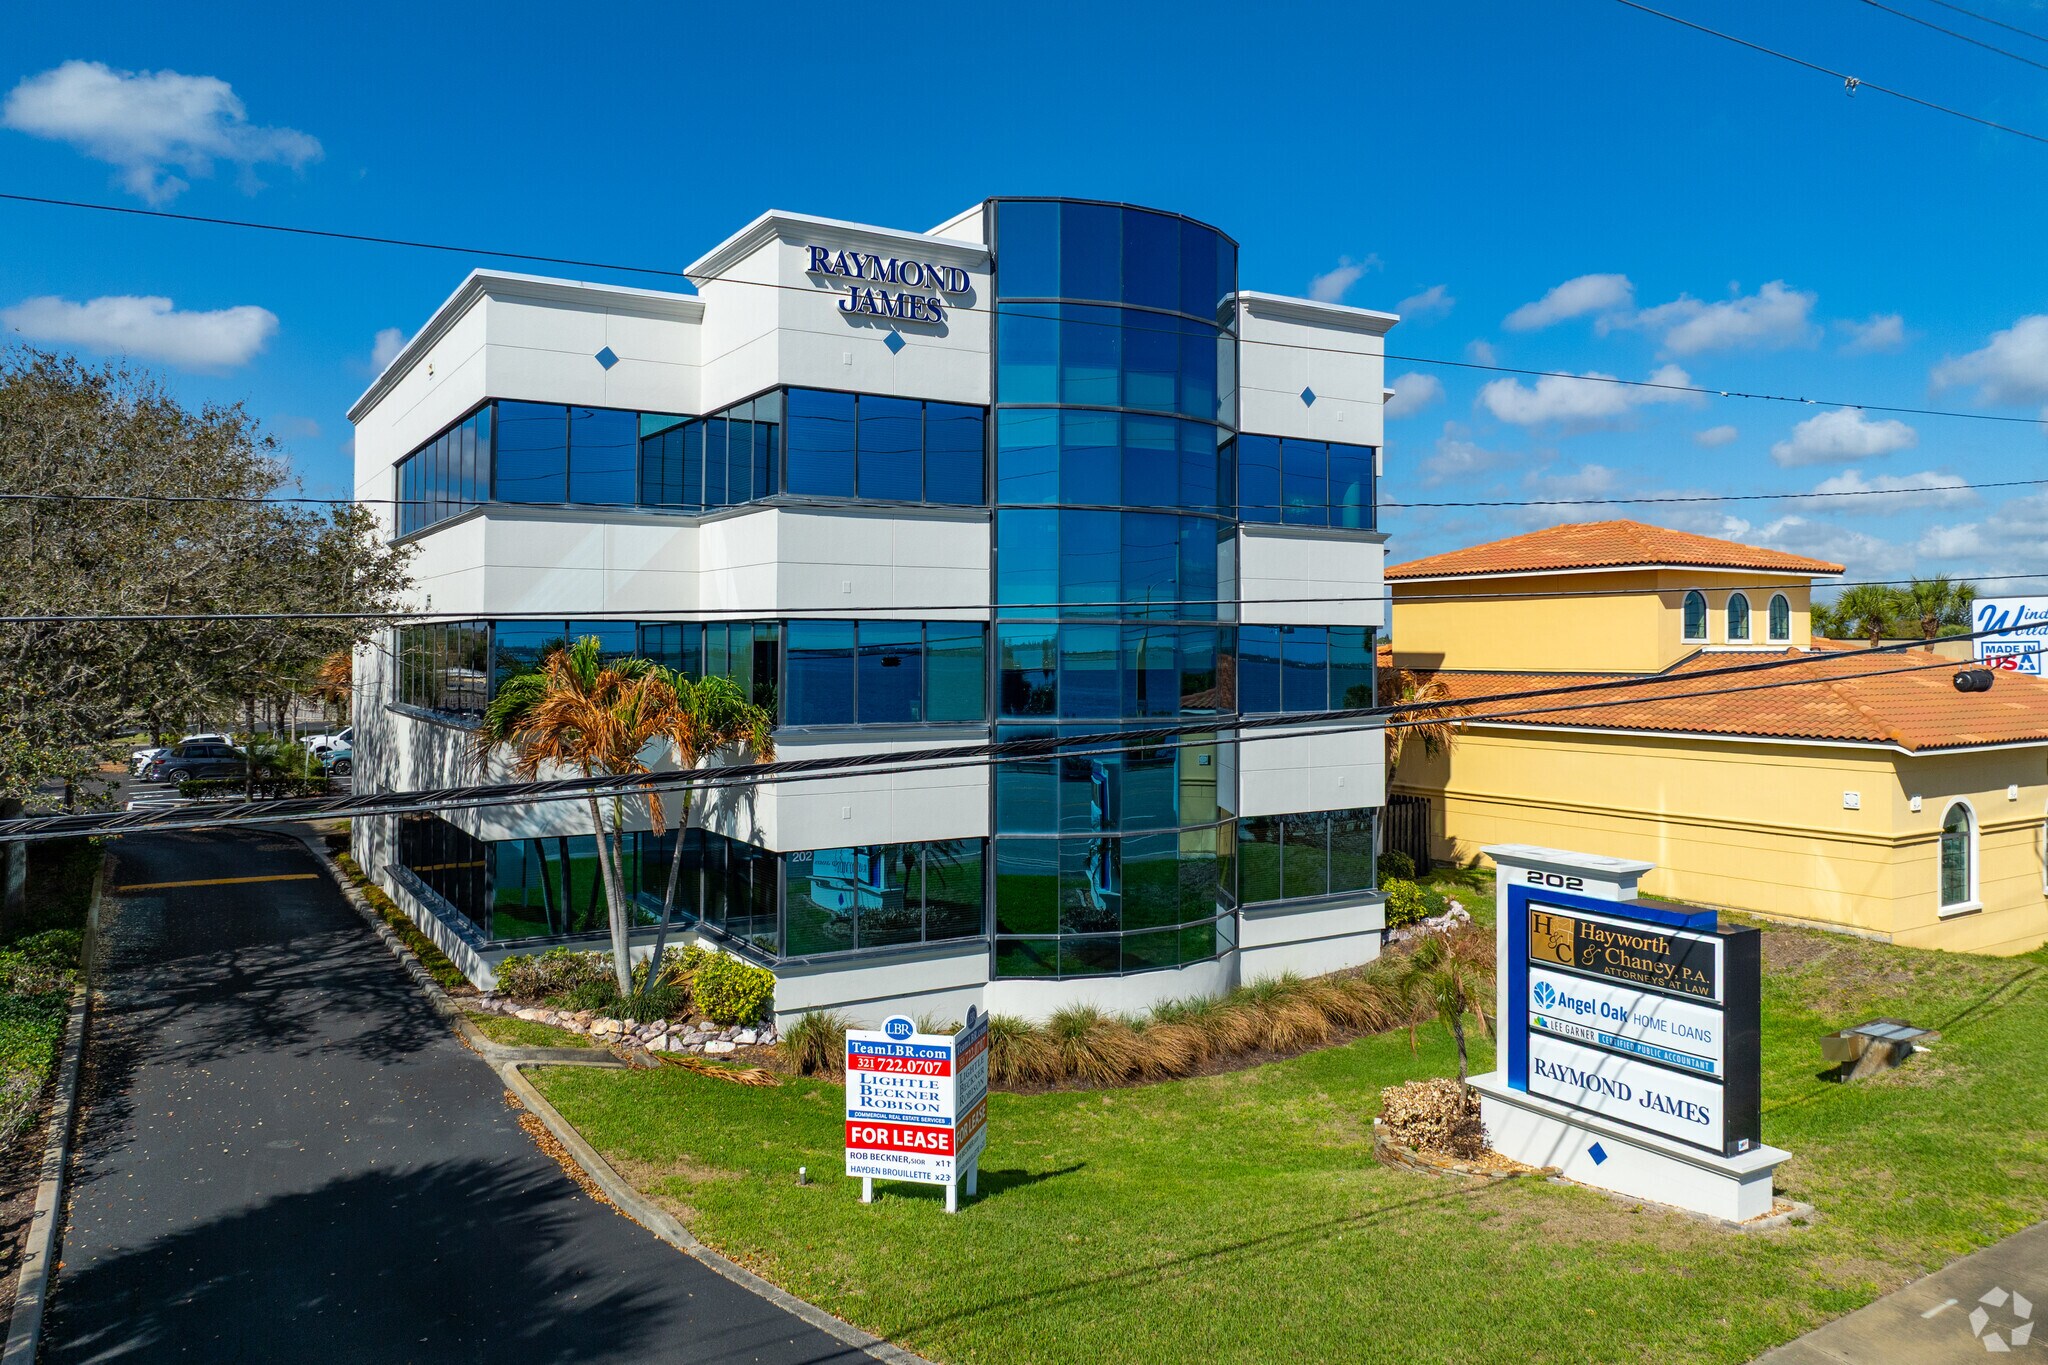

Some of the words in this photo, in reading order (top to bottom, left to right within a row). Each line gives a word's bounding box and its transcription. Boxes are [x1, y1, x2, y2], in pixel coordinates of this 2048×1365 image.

[806, 244, 971, 294] RAYMOND
[838, 285, 943, 324] JAMES
[1985, 645, 2020, 654] MADE
[2023, 645, 2036, 653] IN
[792, 851, 813, 863] 202
[1527, 870, 1584, 892] 202
[1580, 921, 1671, 956] Hayworth
[1581, 943, 1602, 966] &
[1604, 947, 1678, 981] Chaney,
[1682, 968, 1710, 984] P.A.
[1603, 966, 1665, 987] ATTORNEYS
[1668, 980, 1681, 991] AT
[1684, 984, 1710, 996] LAW
[1557, 992, 1596, 1016] Angel
[1600, 1001, 1628, 1023] Oak
[1633, 1013, 1667, 1033] HOME
[1671, 1022, 1712, 1043] LOANS
[886, 1022, 911, 1036] LBR
[852, 1041, 947, 1060] TeamLBR.com
[1550, 1020, 1563, 1033] LEE
[1565, 1024, 1595, 1041] GARNER
[1601, 1035, 1634, 1051] CERTIFIED
[1637, 1045, 1661, 1059] PUBLIC
[1664, 1053, 1709, 1072] ACCOUNTANT
[857, 1057, 874, 1068] 321
[877, 1057, 942, 1075] 722.0707
[859, 1073, 940, 1090] LIGHTLE
[1534, 1057, 1632, 1101] RAYMOND
[1638, 1089, 1710, 1126] JAMES
[859, 1084, 941, 1102] BECKNER
[859, 1095, 940, 1113] ROBISON
[854, 1111, 887, 1119] COMMERCIAL
[888, 1113, 902, 1121] REAL
[920, 1117, 946, 1125] SERVICES
[956, 1121, 969, 1149] FOR
[968, 1102, 986, 1134] LEASE
[851, 1126, 889, 1145] FOR
[893, 1129, 949, 1150] LEASE
[850, 1151, 868, 1160] ROB
[850, 1165, 881, 1175] HAYDEN
[882, 1167, 931, 1180] BROUILLETTE
